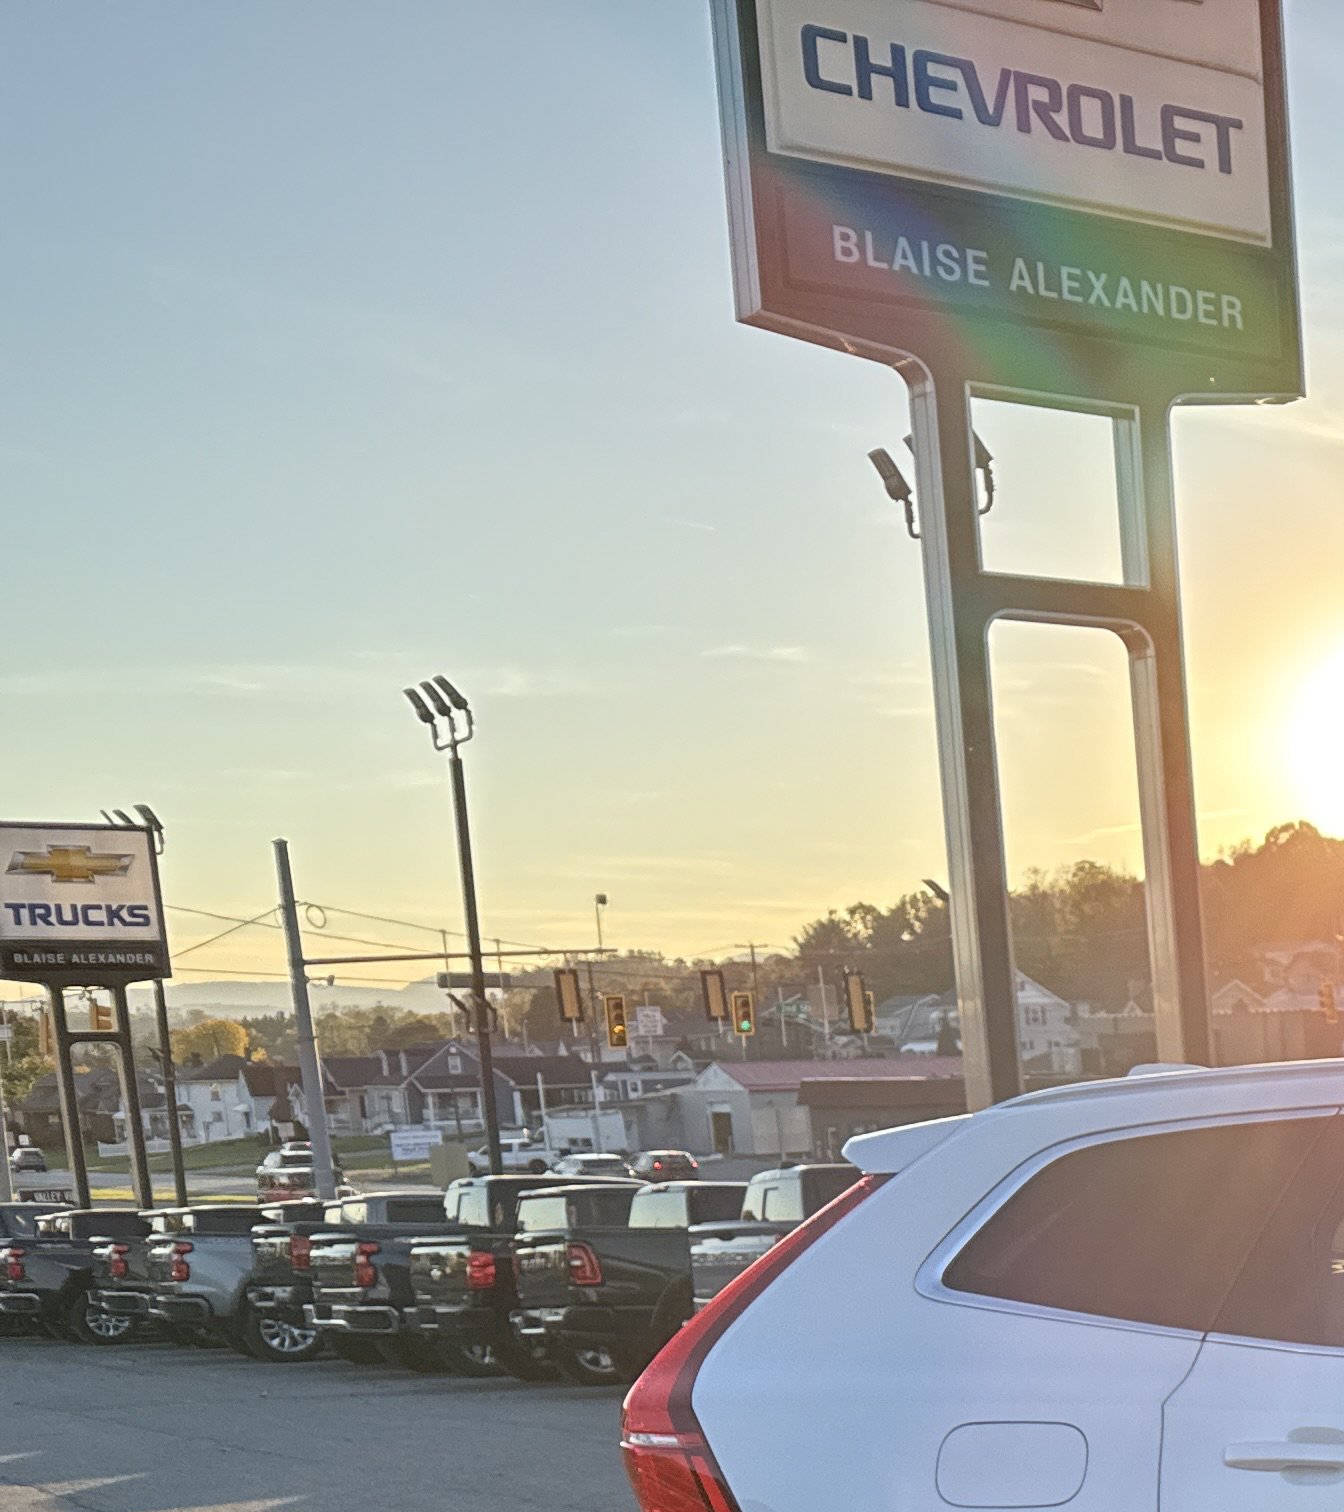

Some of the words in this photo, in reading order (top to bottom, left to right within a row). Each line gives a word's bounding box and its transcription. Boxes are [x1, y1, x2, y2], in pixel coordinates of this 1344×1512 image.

[801, 23, 1243, 174] CHEVROLET
[832, 225, 990, 288] BLAISE
[1009, 258, 1243, 331] ALEXANDER
[4, 902, 151, 927] TRUCKS
[13, 953, 65, 964] BLAISE
[71, 953, 154, 965] ALEXANDER
